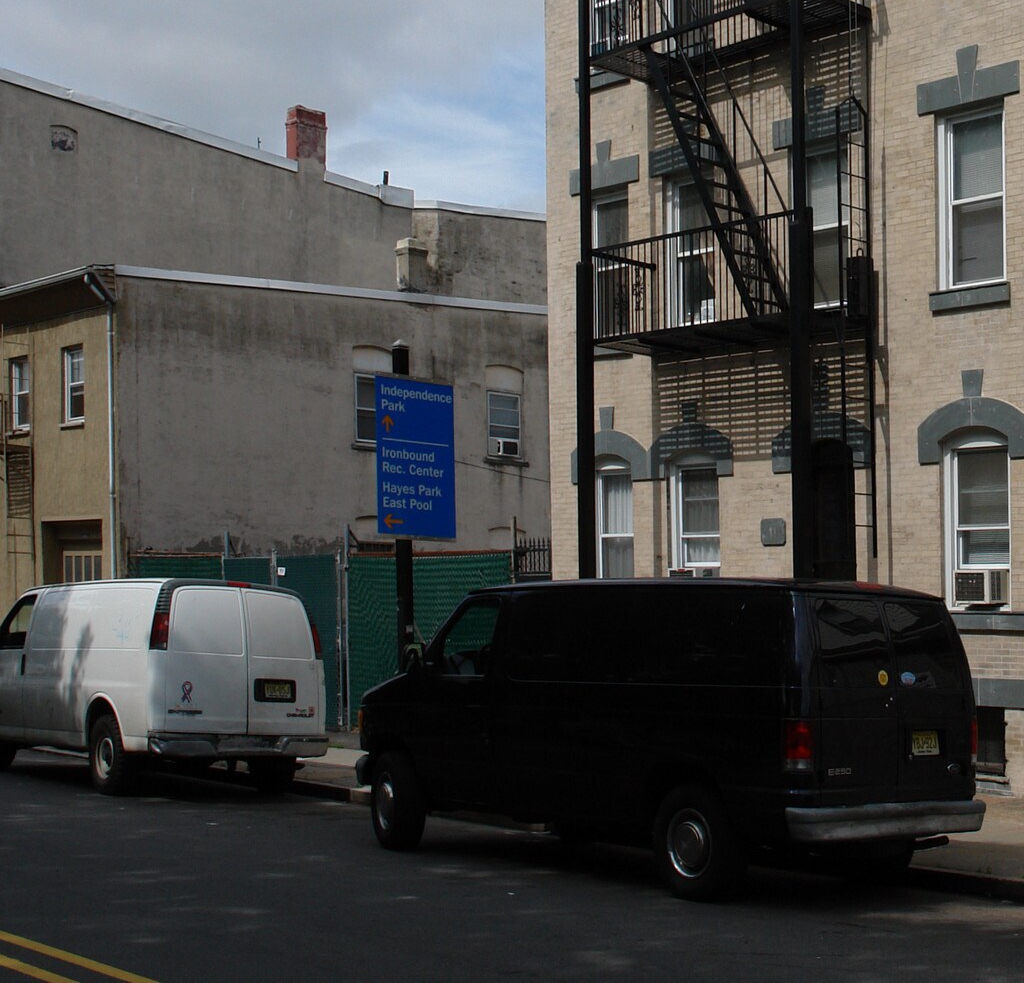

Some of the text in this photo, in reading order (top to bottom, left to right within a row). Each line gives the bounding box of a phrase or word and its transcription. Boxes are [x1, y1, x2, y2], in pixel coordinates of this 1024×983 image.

[380, 383, 452, 404] Independence
[381, 399, 405, 413] Park
[381, 446, 435, 463] Ironbound
[382, 461, 444, 478] Rec. Center
[382, 481, 442, 497] Hayes Park
[383, 497, 433, 511] East Pool
